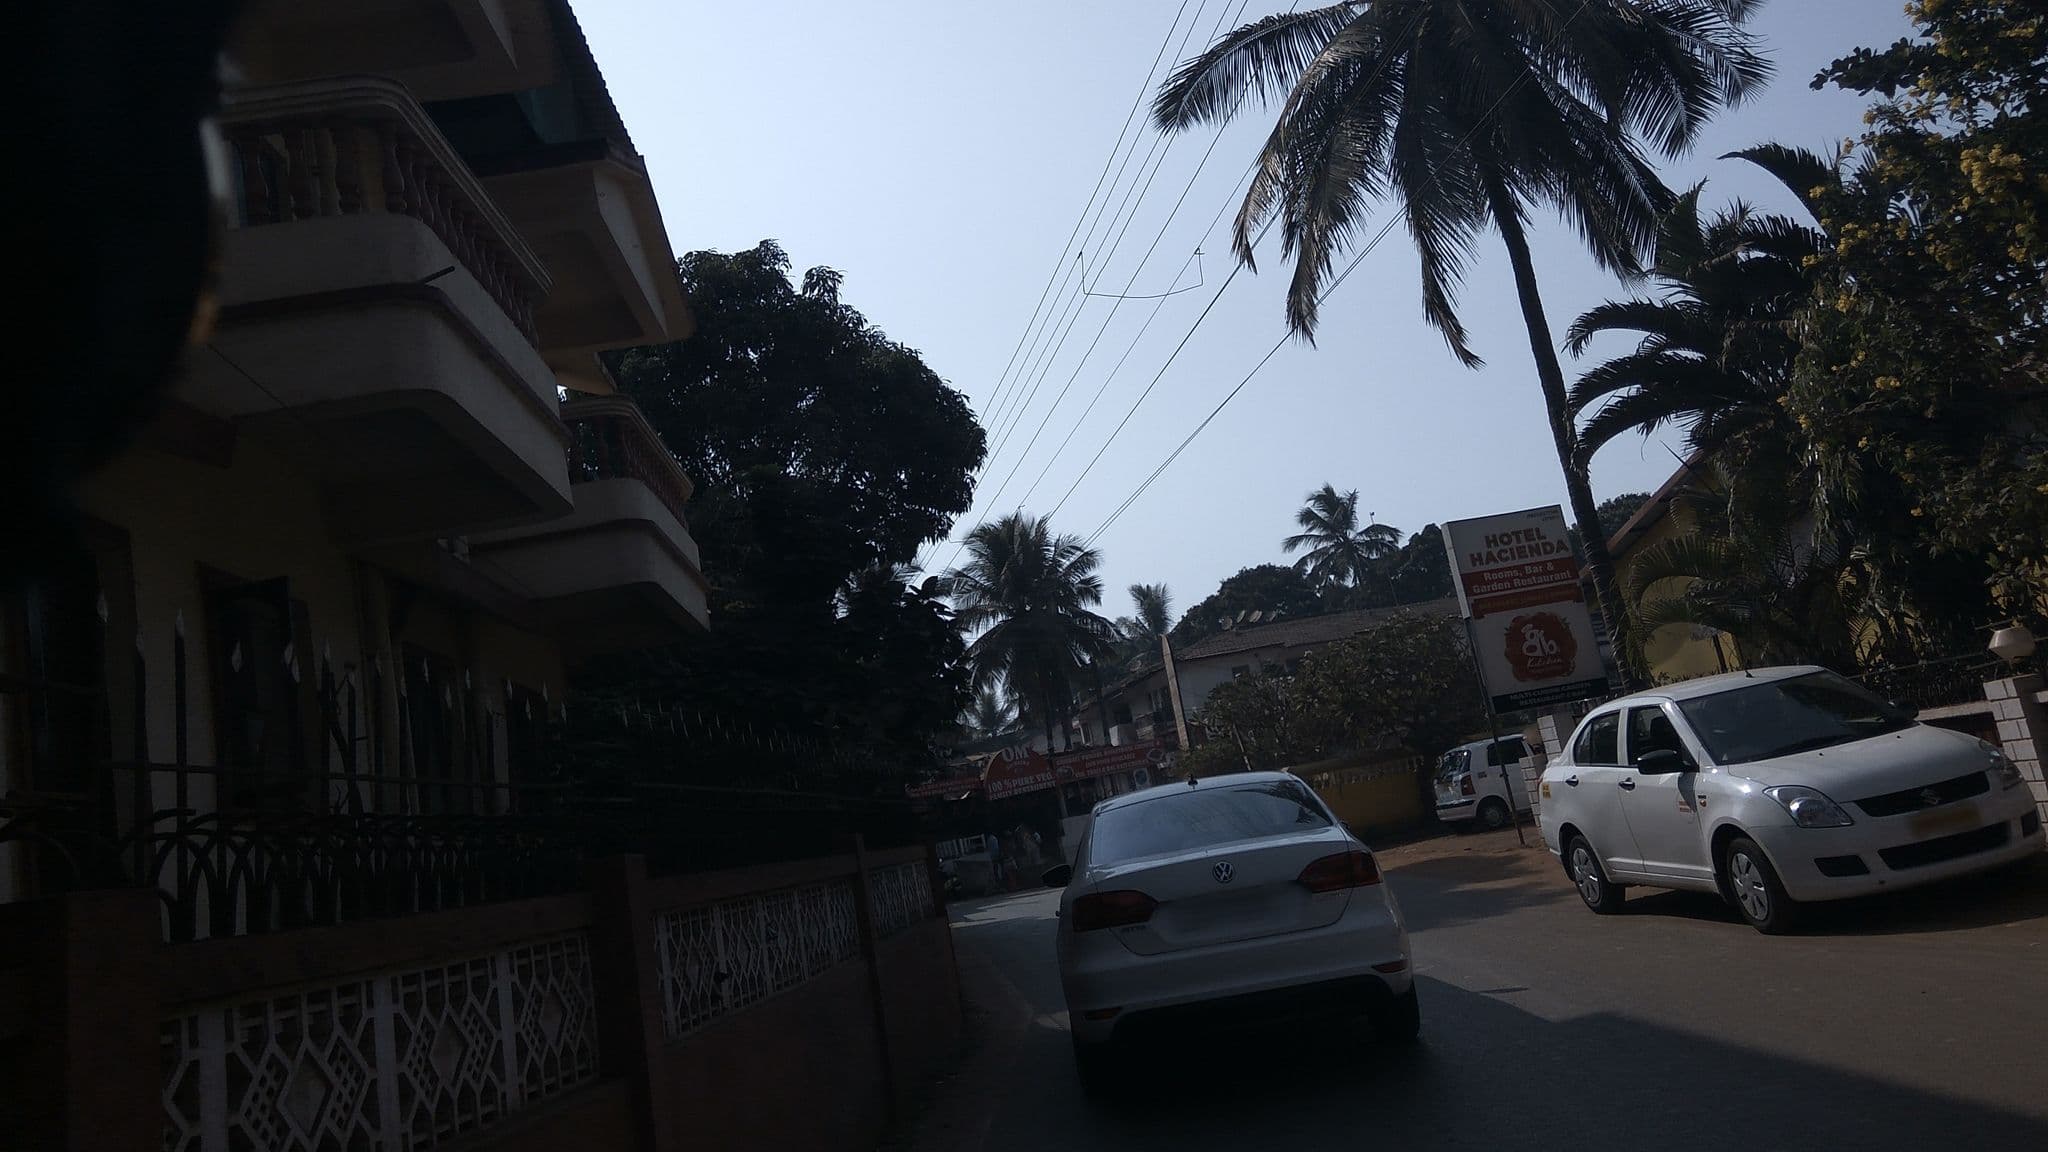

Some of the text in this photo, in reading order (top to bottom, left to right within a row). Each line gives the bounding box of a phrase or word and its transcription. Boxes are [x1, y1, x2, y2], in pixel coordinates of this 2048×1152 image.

[1485, 527, 1547, 548] HOTEL
[1469, 541, 1569, 567] HACIENDA
[1472, 570, 1572, 593] Garden Restaurant
[1483, 562, 1554, 581] Rooms, Bar &
